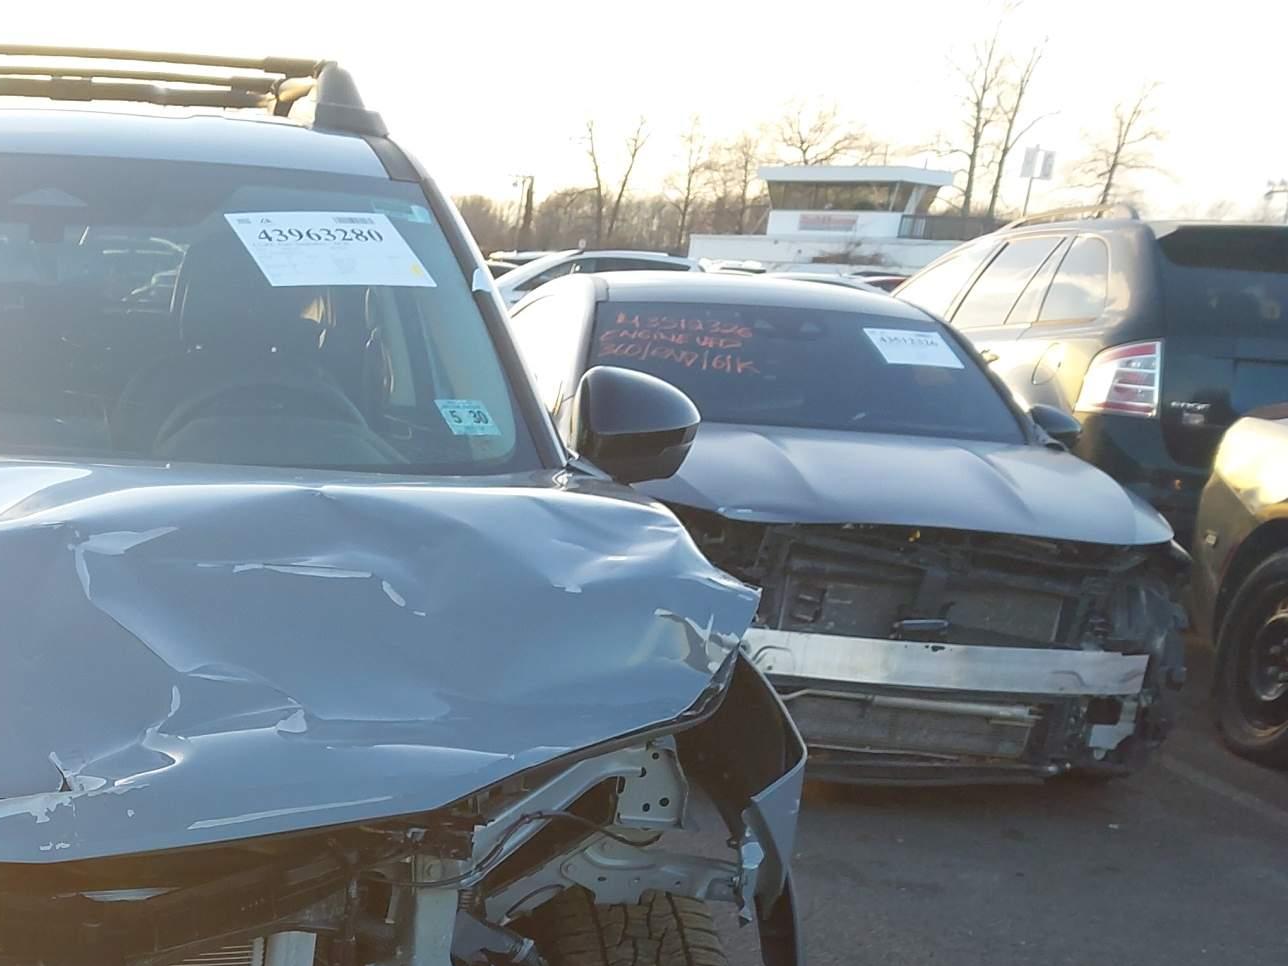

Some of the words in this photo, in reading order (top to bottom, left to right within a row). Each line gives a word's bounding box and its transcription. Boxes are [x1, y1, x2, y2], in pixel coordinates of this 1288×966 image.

[257, 227, 384, 243] 43963280
[448, 410, 462, 424] 5
[469, 409, 489, 425] 30
